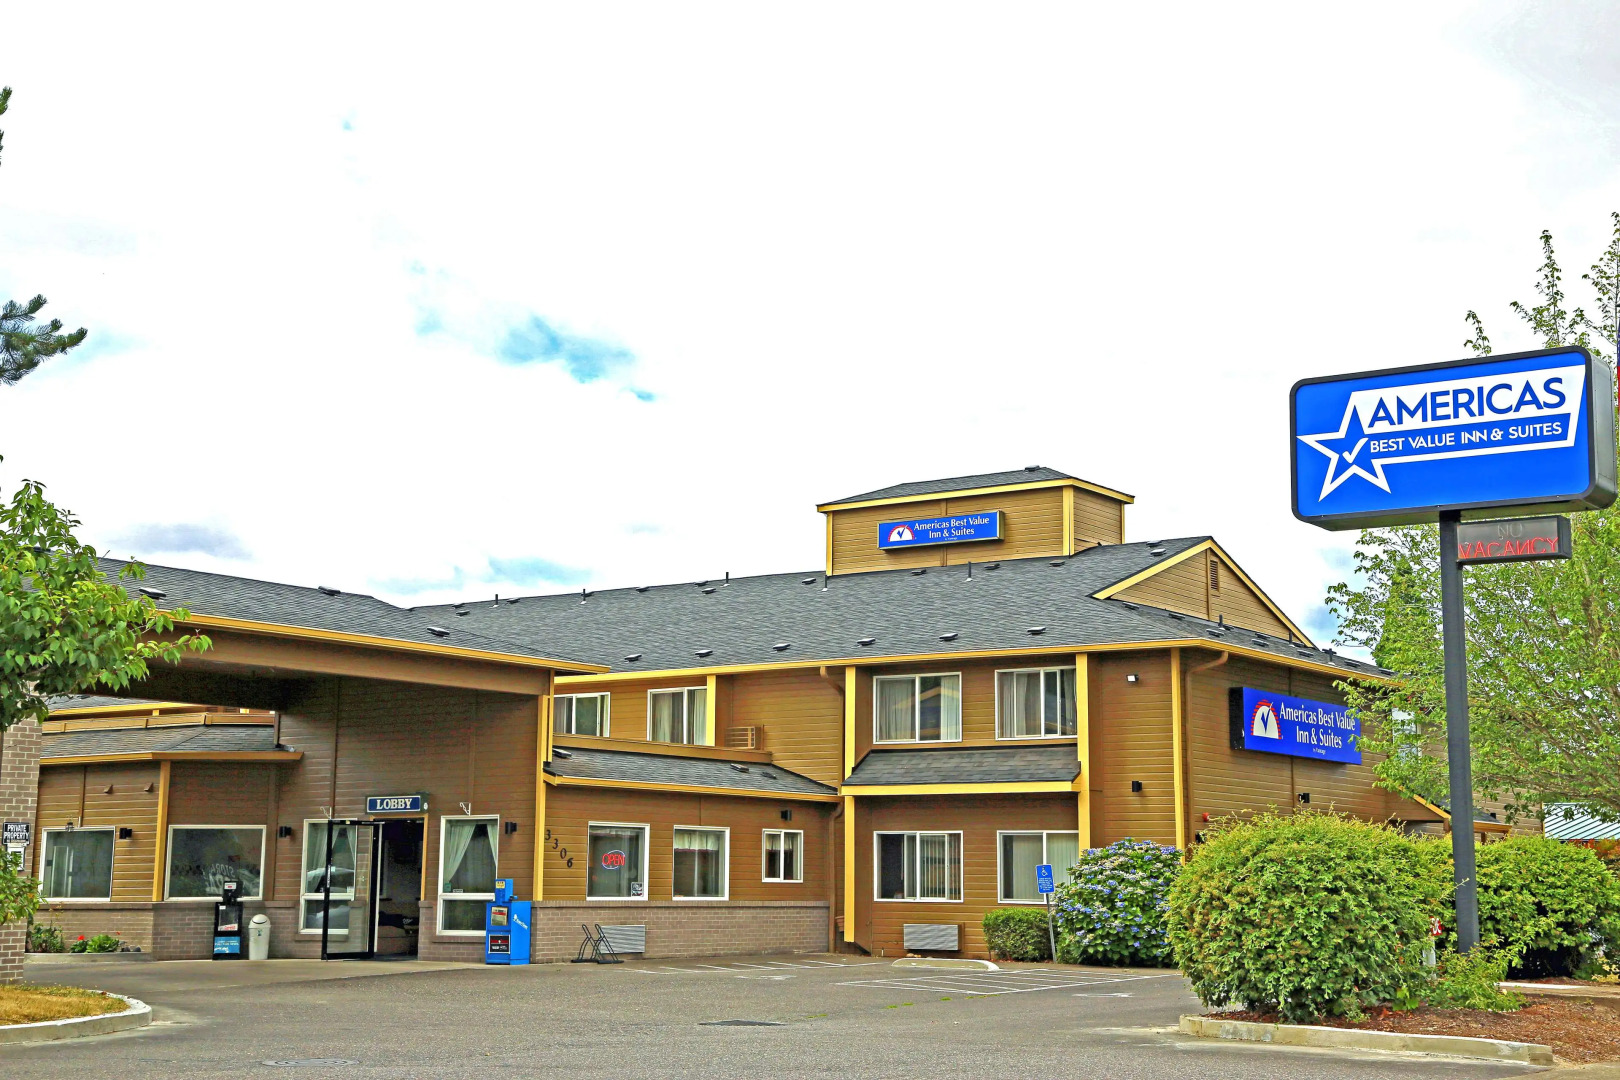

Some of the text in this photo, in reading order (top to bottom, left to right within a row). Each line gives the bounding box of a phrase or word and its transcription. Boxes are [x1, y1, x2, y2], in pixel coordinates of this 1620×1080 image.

[1368, 377, 1566, 429] AMERICAS
[1370, 422, 1563, 453] BEST VALUE INN & SUITES
[913, 516, 990, 531] Americas Best Value
[929, 527, 975, 538] Inn & Suites
[1497, 522, 1523, 538] NO
[1458, 536, 1559, 559] VACANCY
[1280, 702, 1356, 731] Americas Best Value
[1296, 725, 1342, 749] Inn & Suites
[376, 799, 412, 809] LOBBY
[544, 829, 574, 868] 3306
[602, 853, 625, 865] OPEN
